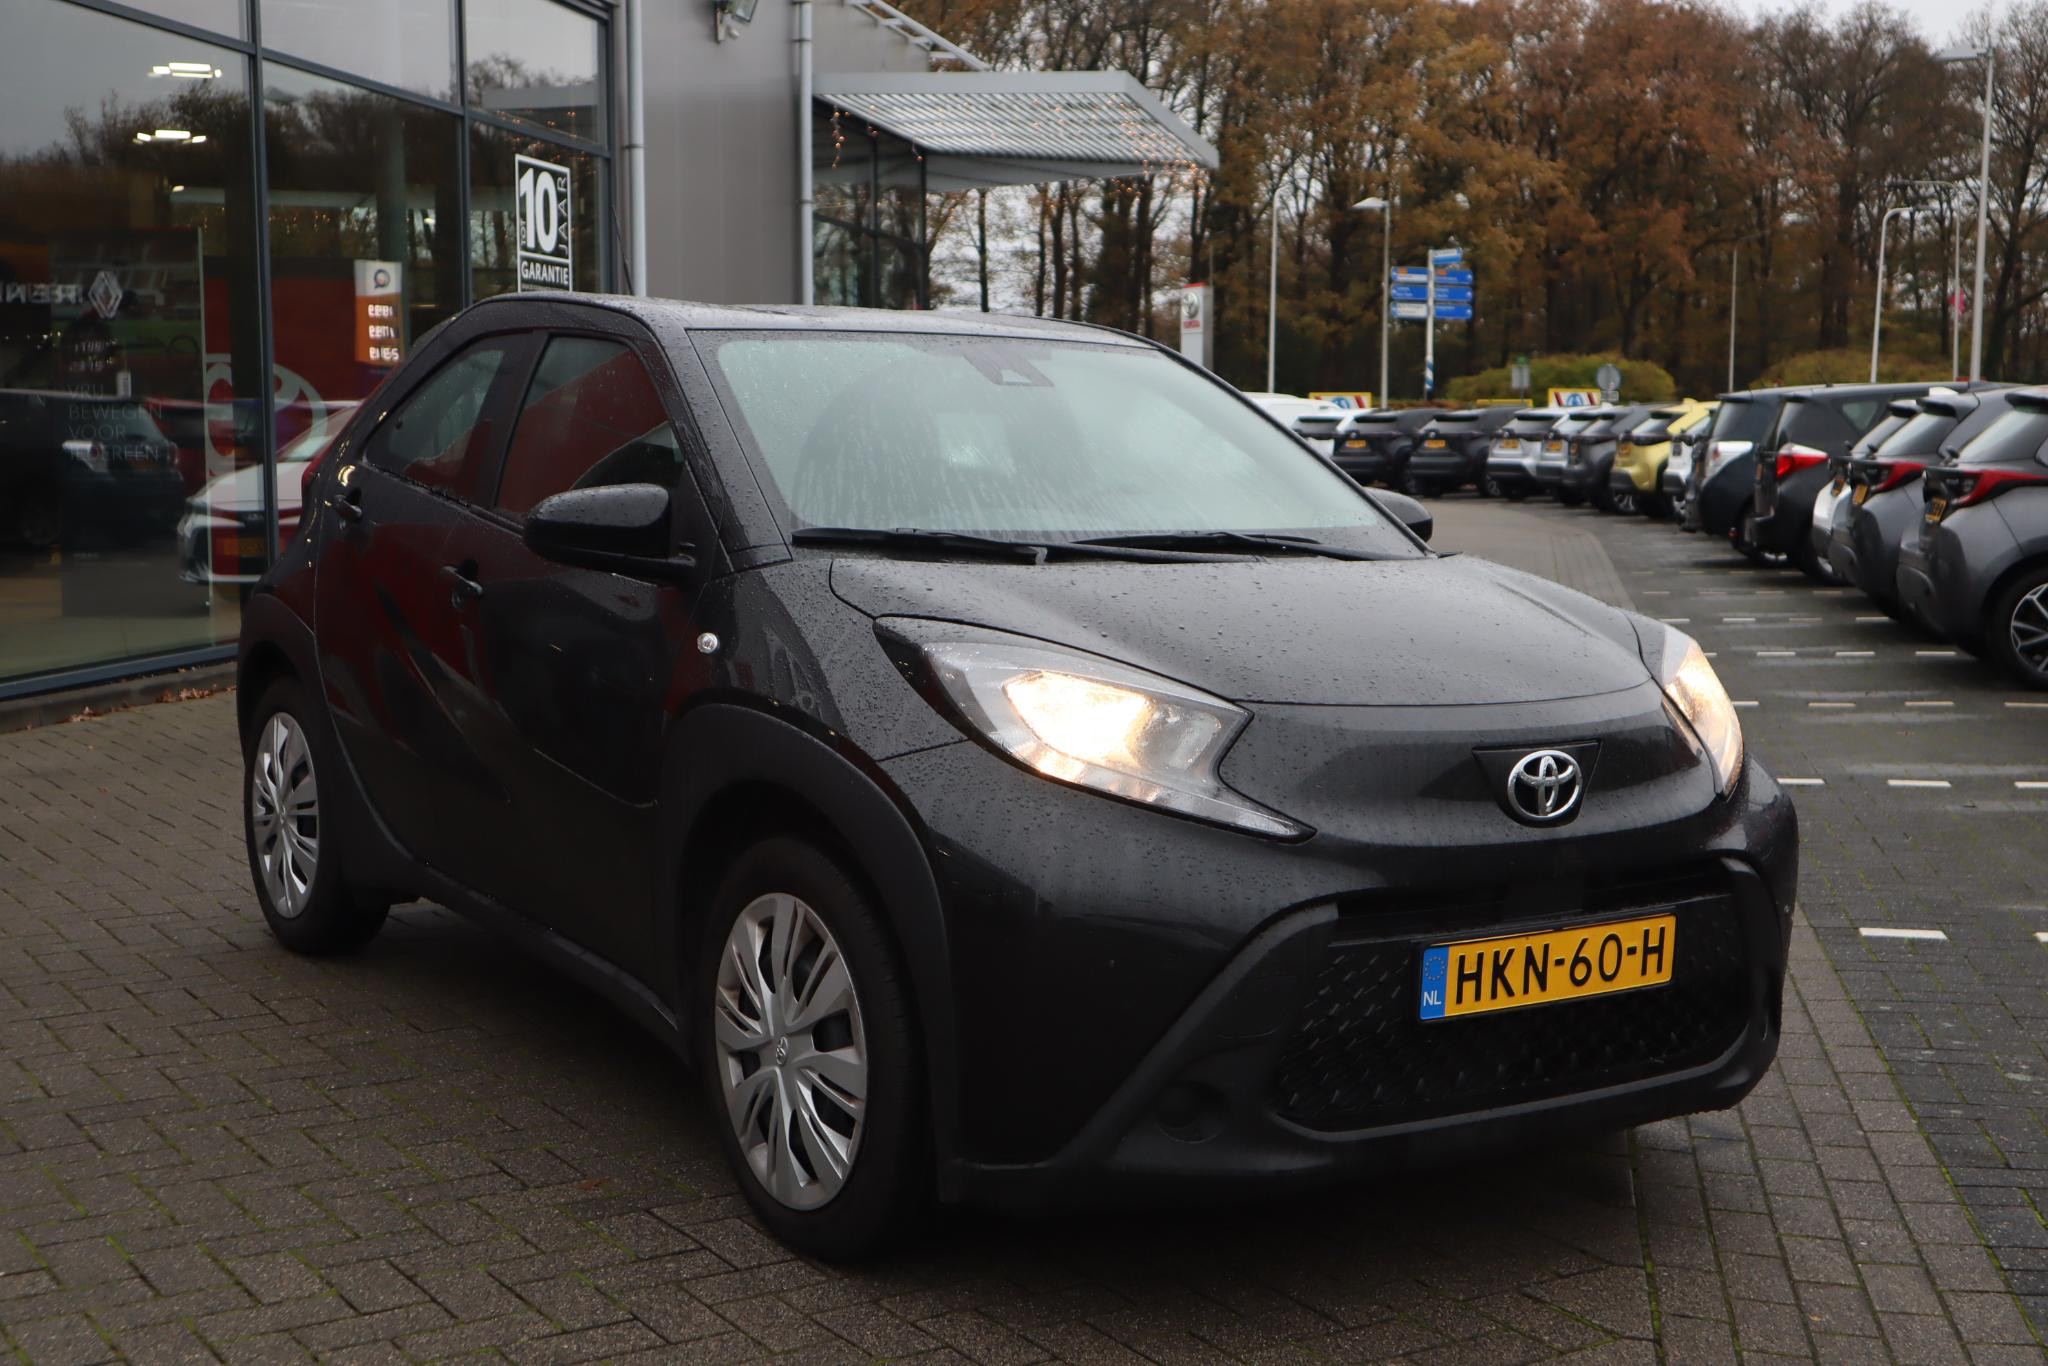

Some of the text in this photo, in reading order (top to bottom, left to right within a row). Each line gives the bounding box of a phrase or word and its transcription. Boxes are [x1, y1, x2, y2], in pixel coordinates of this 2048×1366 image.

[519, 167, 558, 252] 10
[557, 176, 569, 257] JAAR
[521, 260, 569, 285] GARANTIE
[67, 423, 126, 441] VOOR
[1455, 926, 1666, 1005] HKN-60-H
[1423, 990, 1442, 1007] NL
